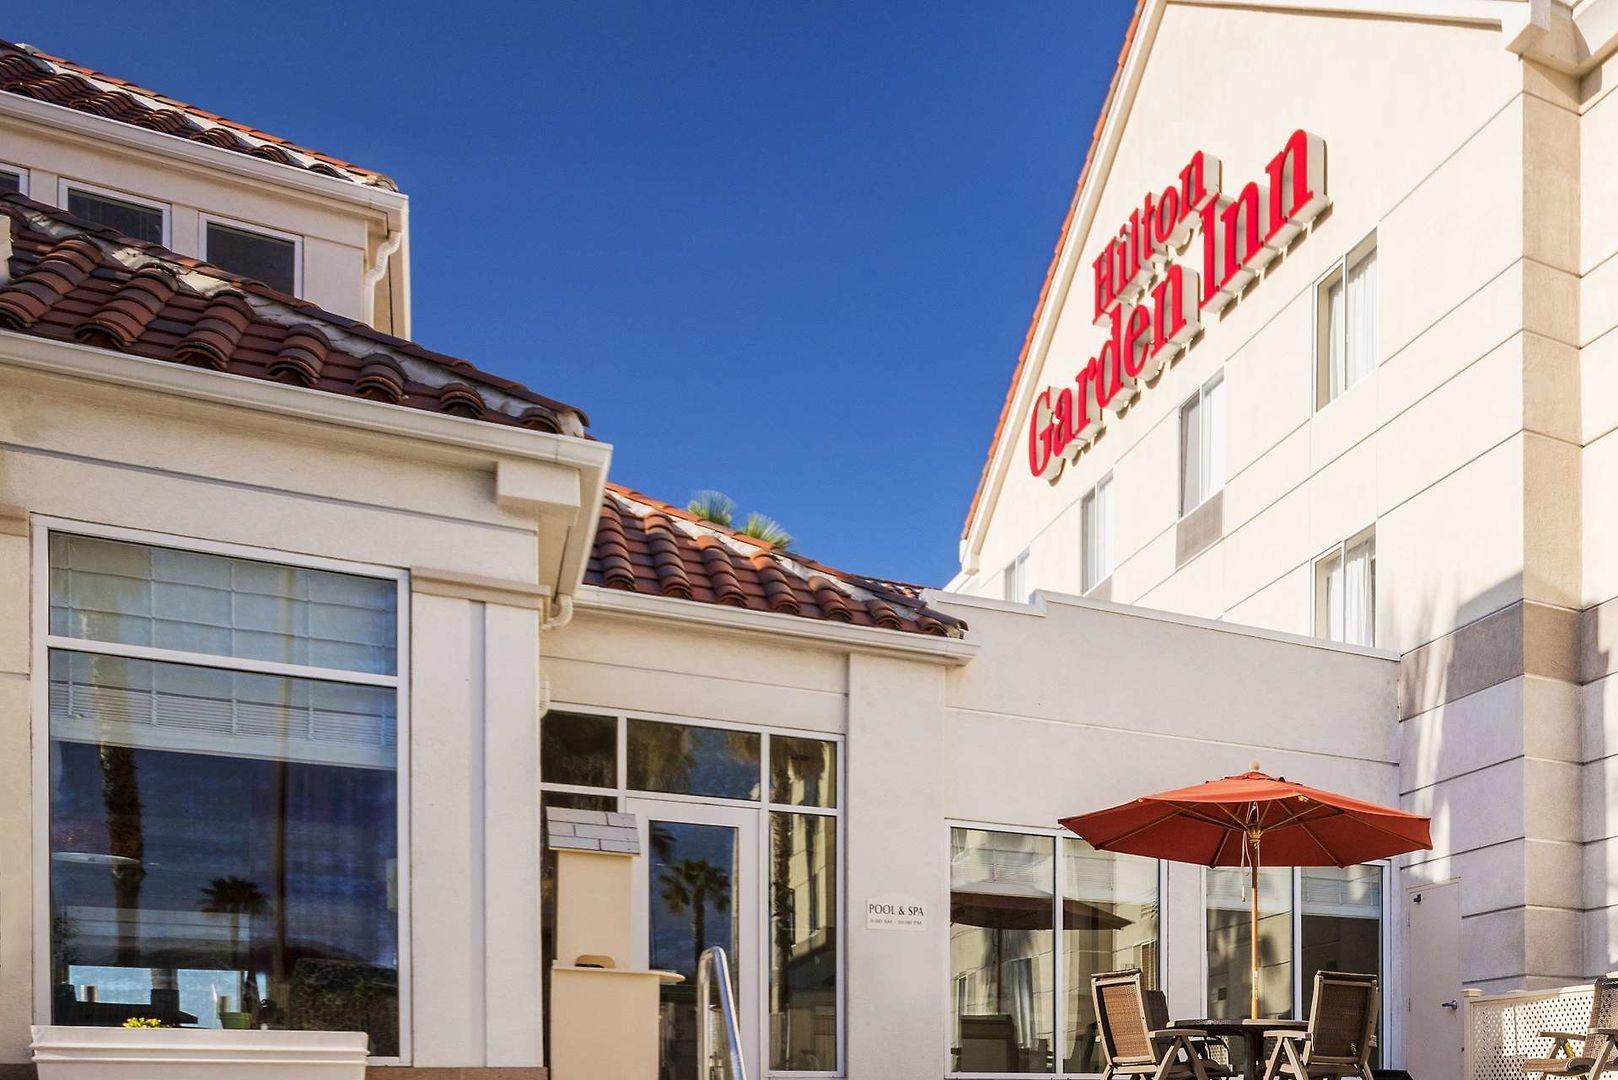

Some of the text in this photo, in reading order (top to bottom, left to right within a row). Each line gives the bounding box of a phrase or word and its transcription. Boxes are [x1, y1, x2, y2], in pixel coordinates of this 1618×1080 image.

[1028, 129, 1314, 476] Garden Inn
[1092, 150, 1207, 325] Hilton
[869, 904, 924, 916] POOL & SPA
